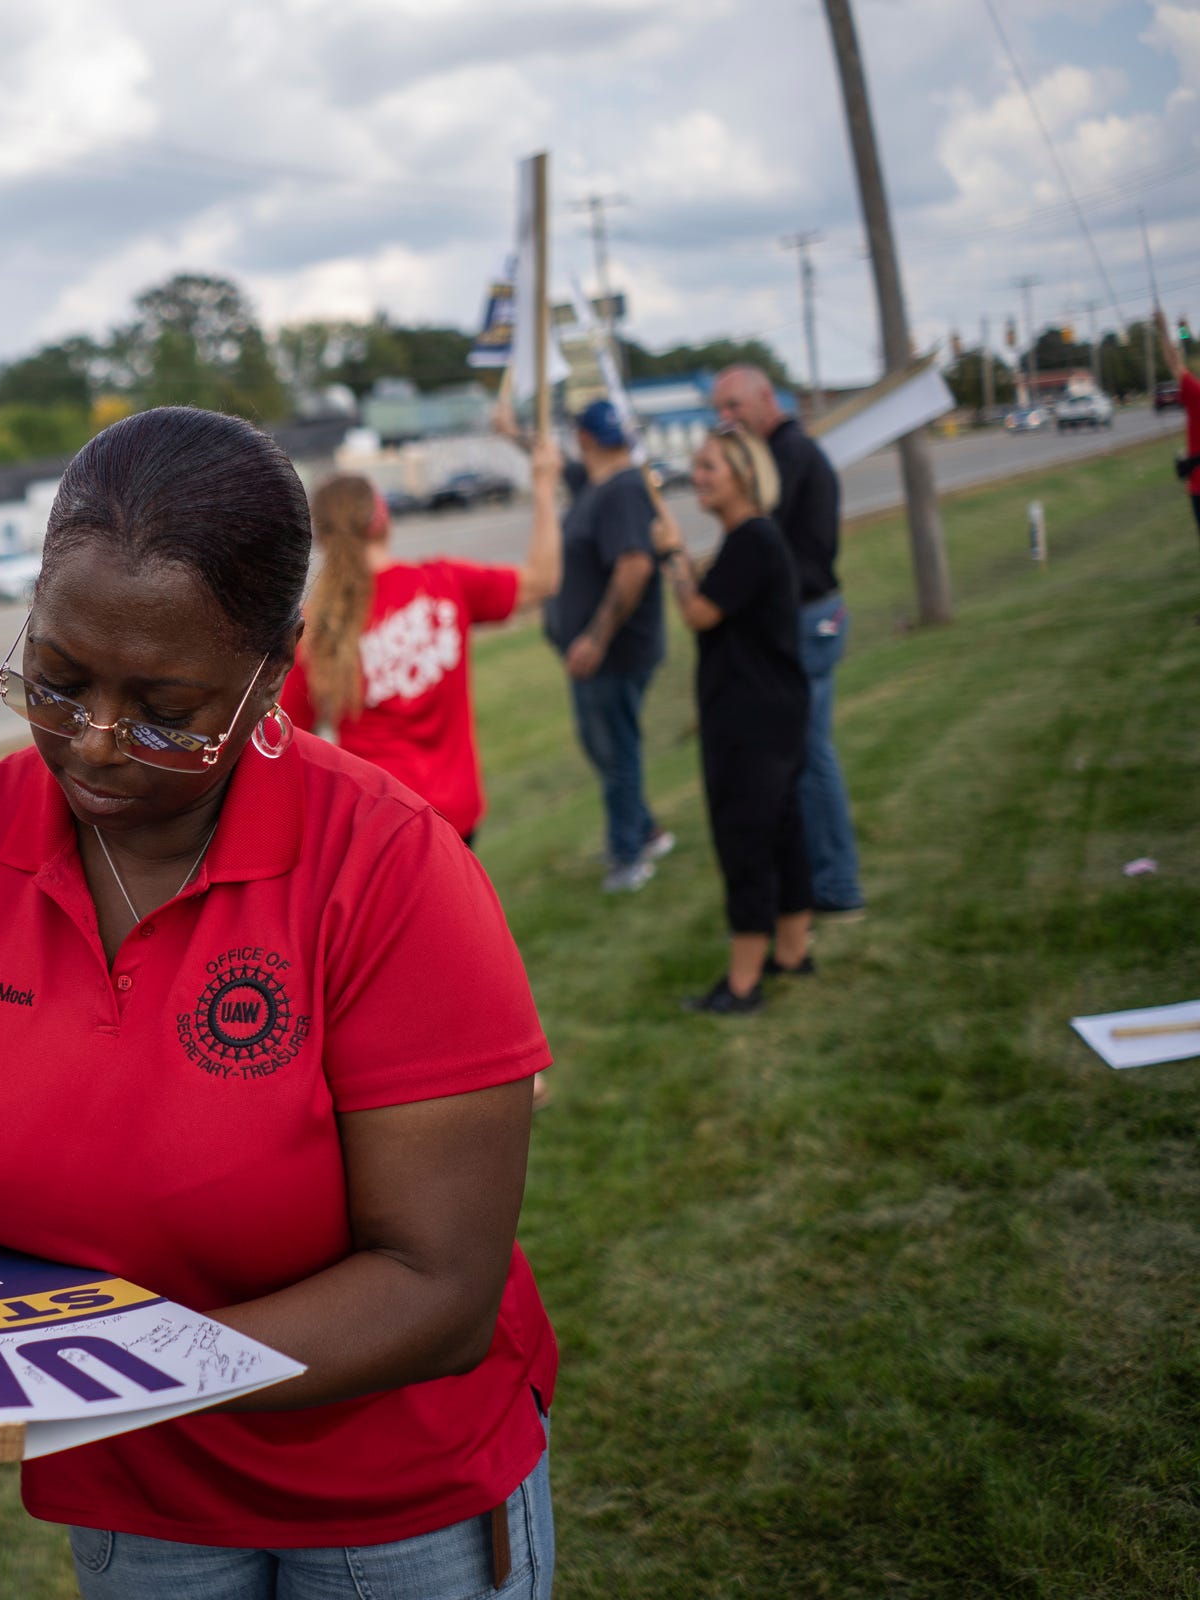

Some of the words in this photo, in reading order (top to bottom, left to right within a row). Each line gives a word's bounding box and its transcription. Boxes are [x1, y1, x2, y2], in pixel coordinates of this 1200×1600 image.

[205, 947, 264, 974] OFFICE
[265, 952, 292, 972] OF
[220, 1001, 261, 1024] UAW
